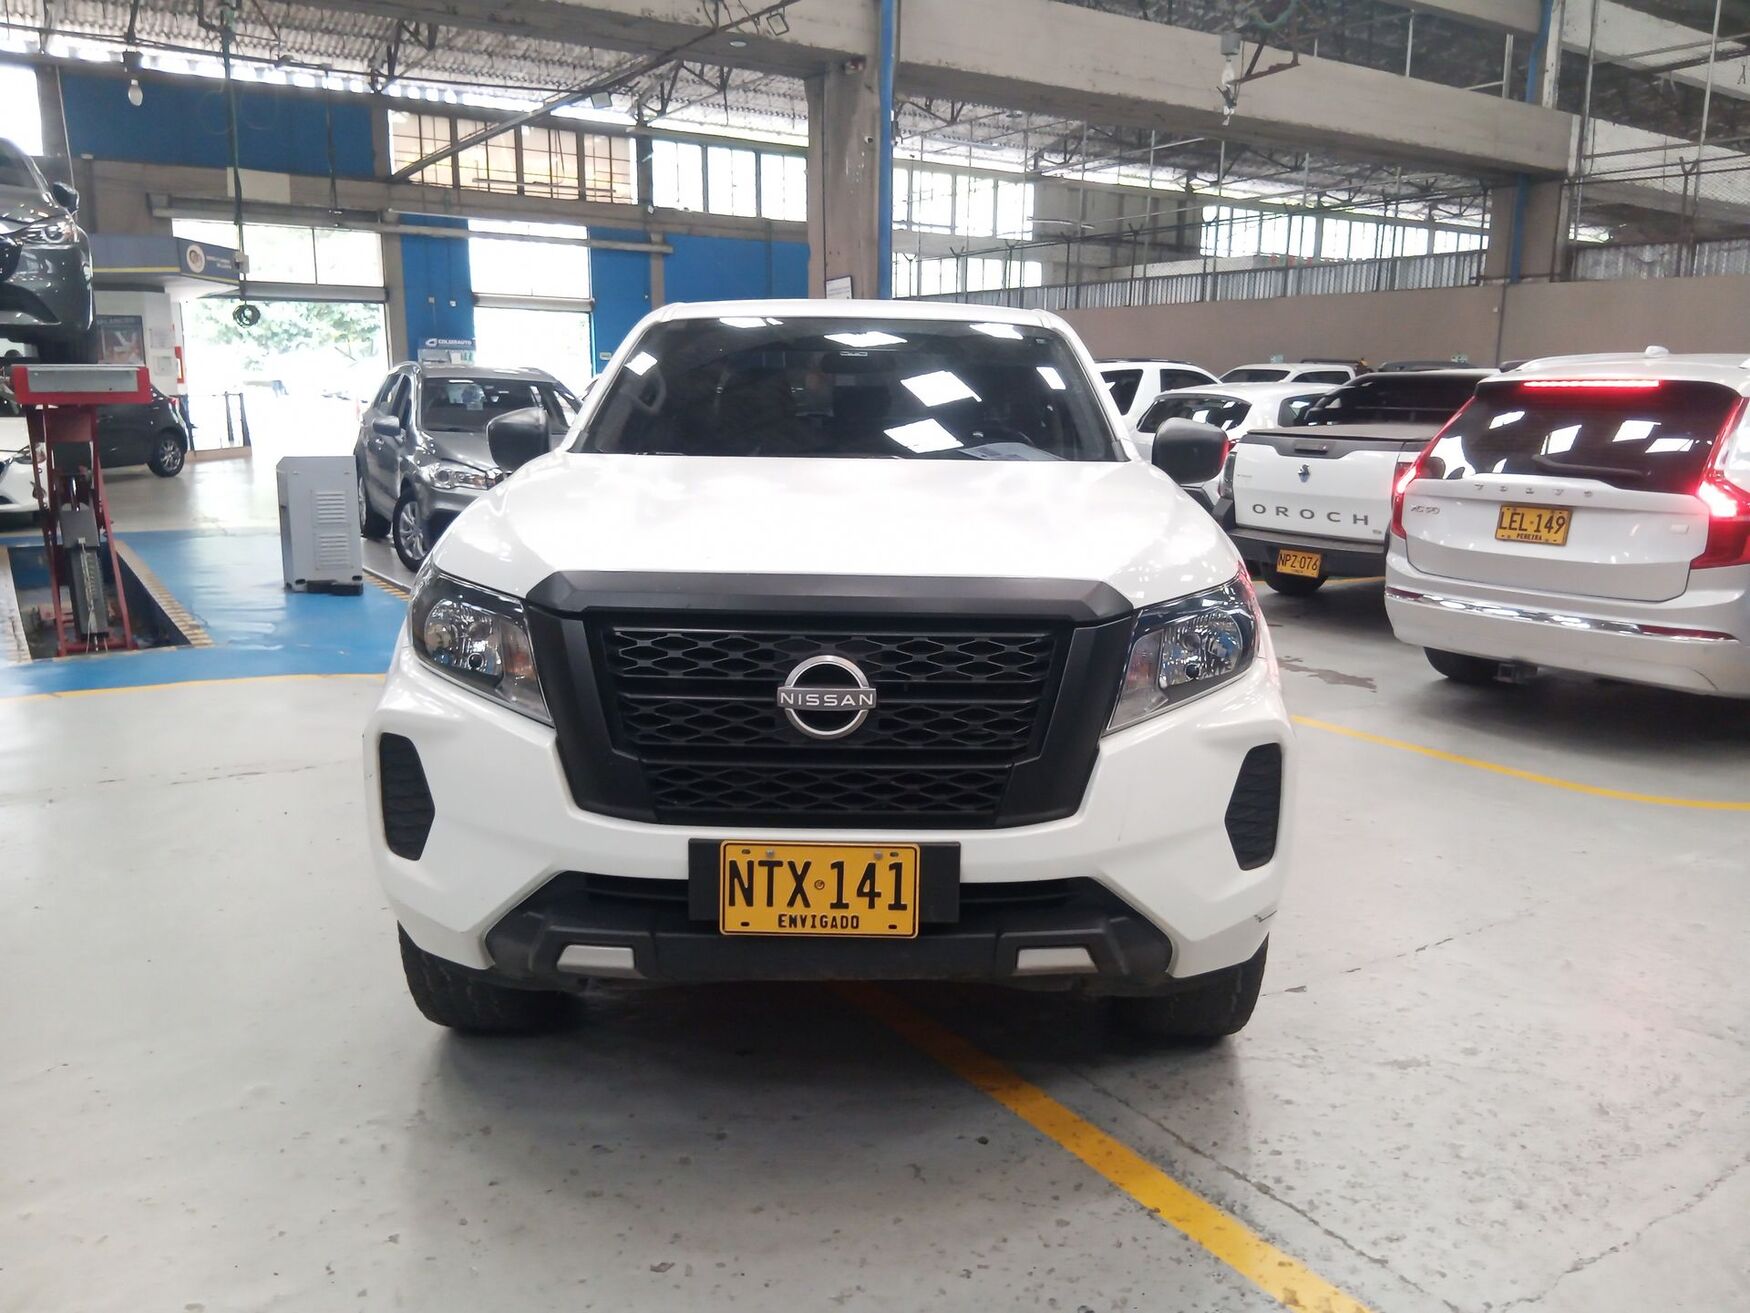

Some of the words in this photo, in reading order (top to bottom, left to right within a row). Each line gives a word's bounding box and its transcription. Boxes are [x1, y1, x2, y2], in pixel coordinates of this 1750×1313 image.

[1252, 503, 1369, 526] OROCH
[1498, 511, 1528, 531] LEL
[1533, 513, 1566, 534] 149
[1278, 552, 1298, 568] NPZ
[1299, 555, 1319, 571] 076
[780, 692, 873, 706] NISSAN
[728, 859, 812, 908] NTX
[829, 860, 908, 911] 141
[777, 913, 860, 929] ENVIGADO
